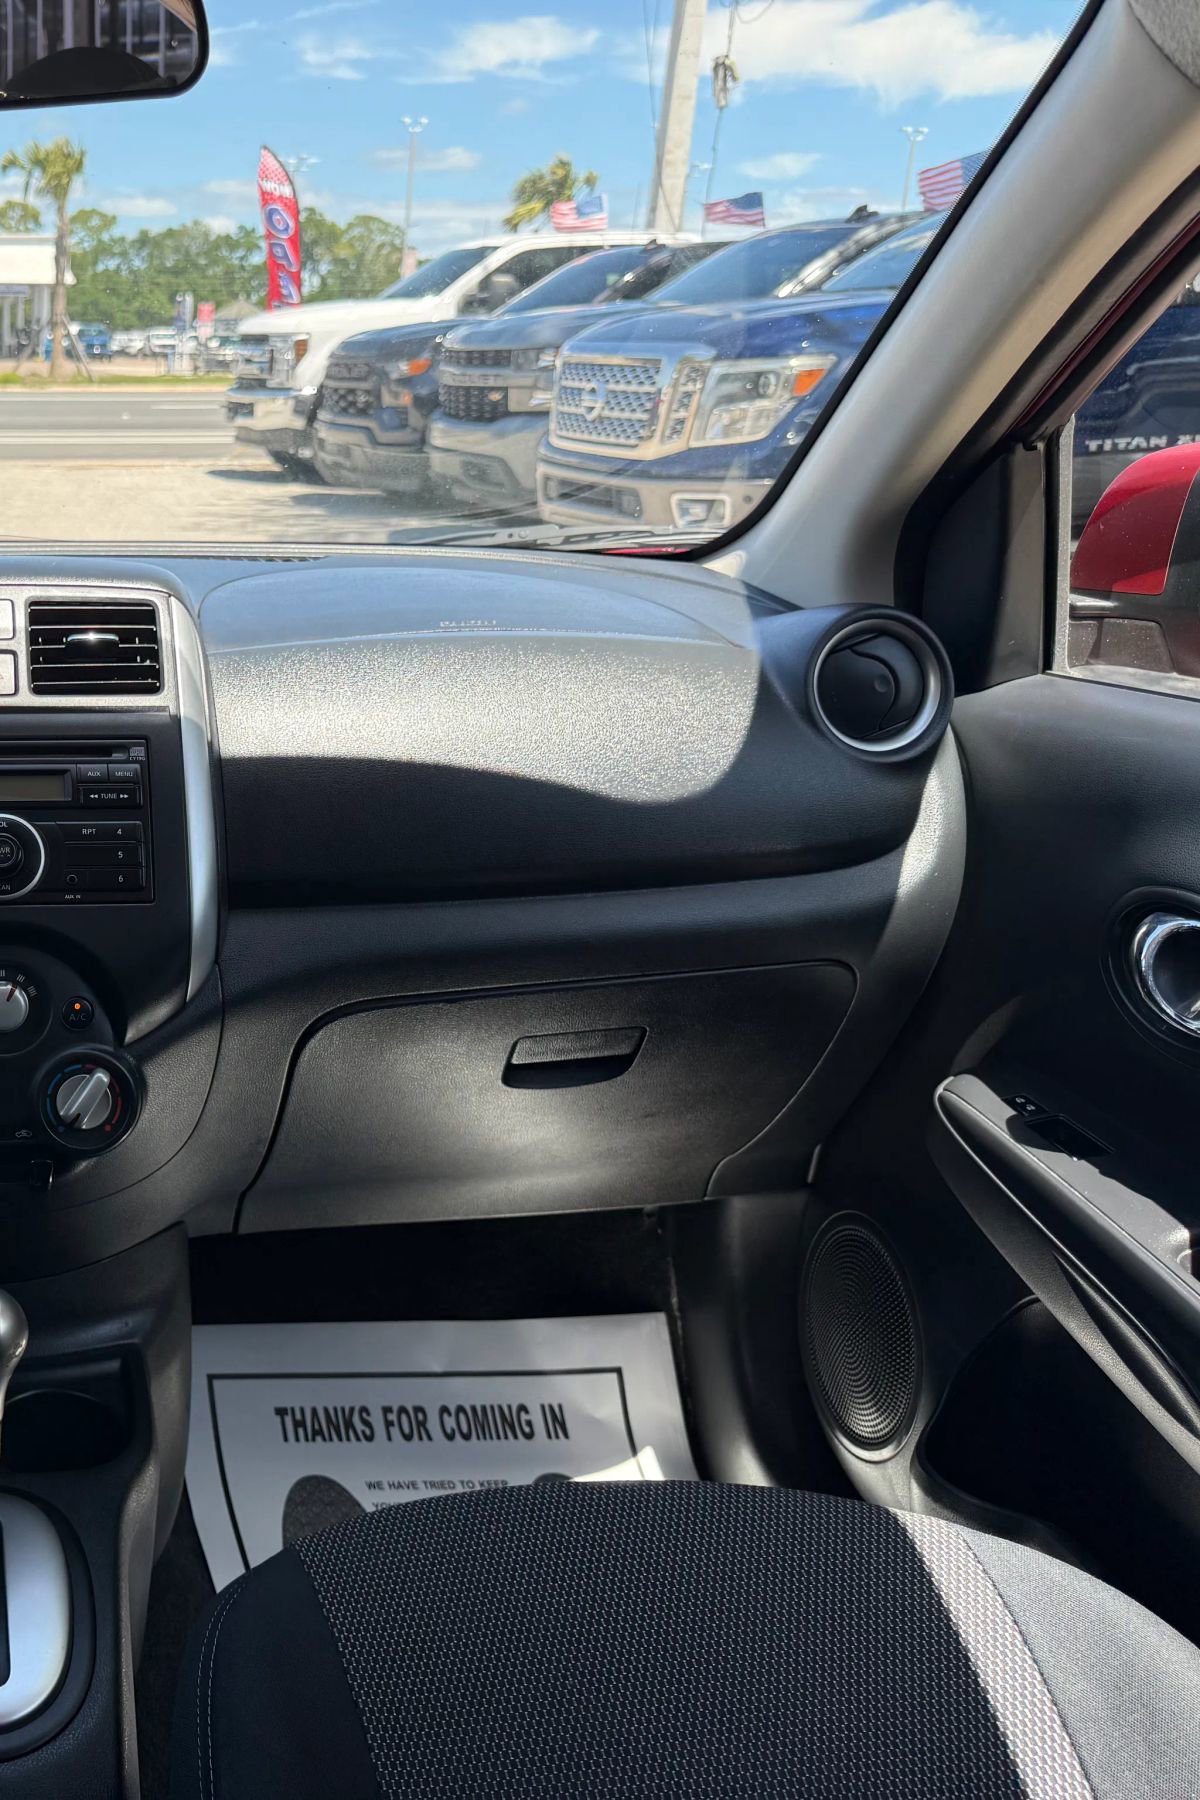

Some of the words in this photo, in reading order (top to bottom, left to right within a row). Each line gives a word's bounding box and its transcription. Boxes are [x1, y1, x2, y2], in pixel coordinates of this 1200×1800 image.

[264, 204, 301, 310] OPE
[1085, 436, 1168, 452] TITAN
[274, 1405, 375, 1443] THANKS
[381, 1405, 432, 1442] FOR
[438, 1402, 535, 1441] COMING
[540, 1403, 570, 1440] IN
[365, 1480, 385, 1491] WE
[387, 1480, 419, 1491] HAVE
[421, 1480, 456, 1490] TRIED
[459, 1480, 475, 1490] TO
[478, 1480, 508, 1488] KEEP
